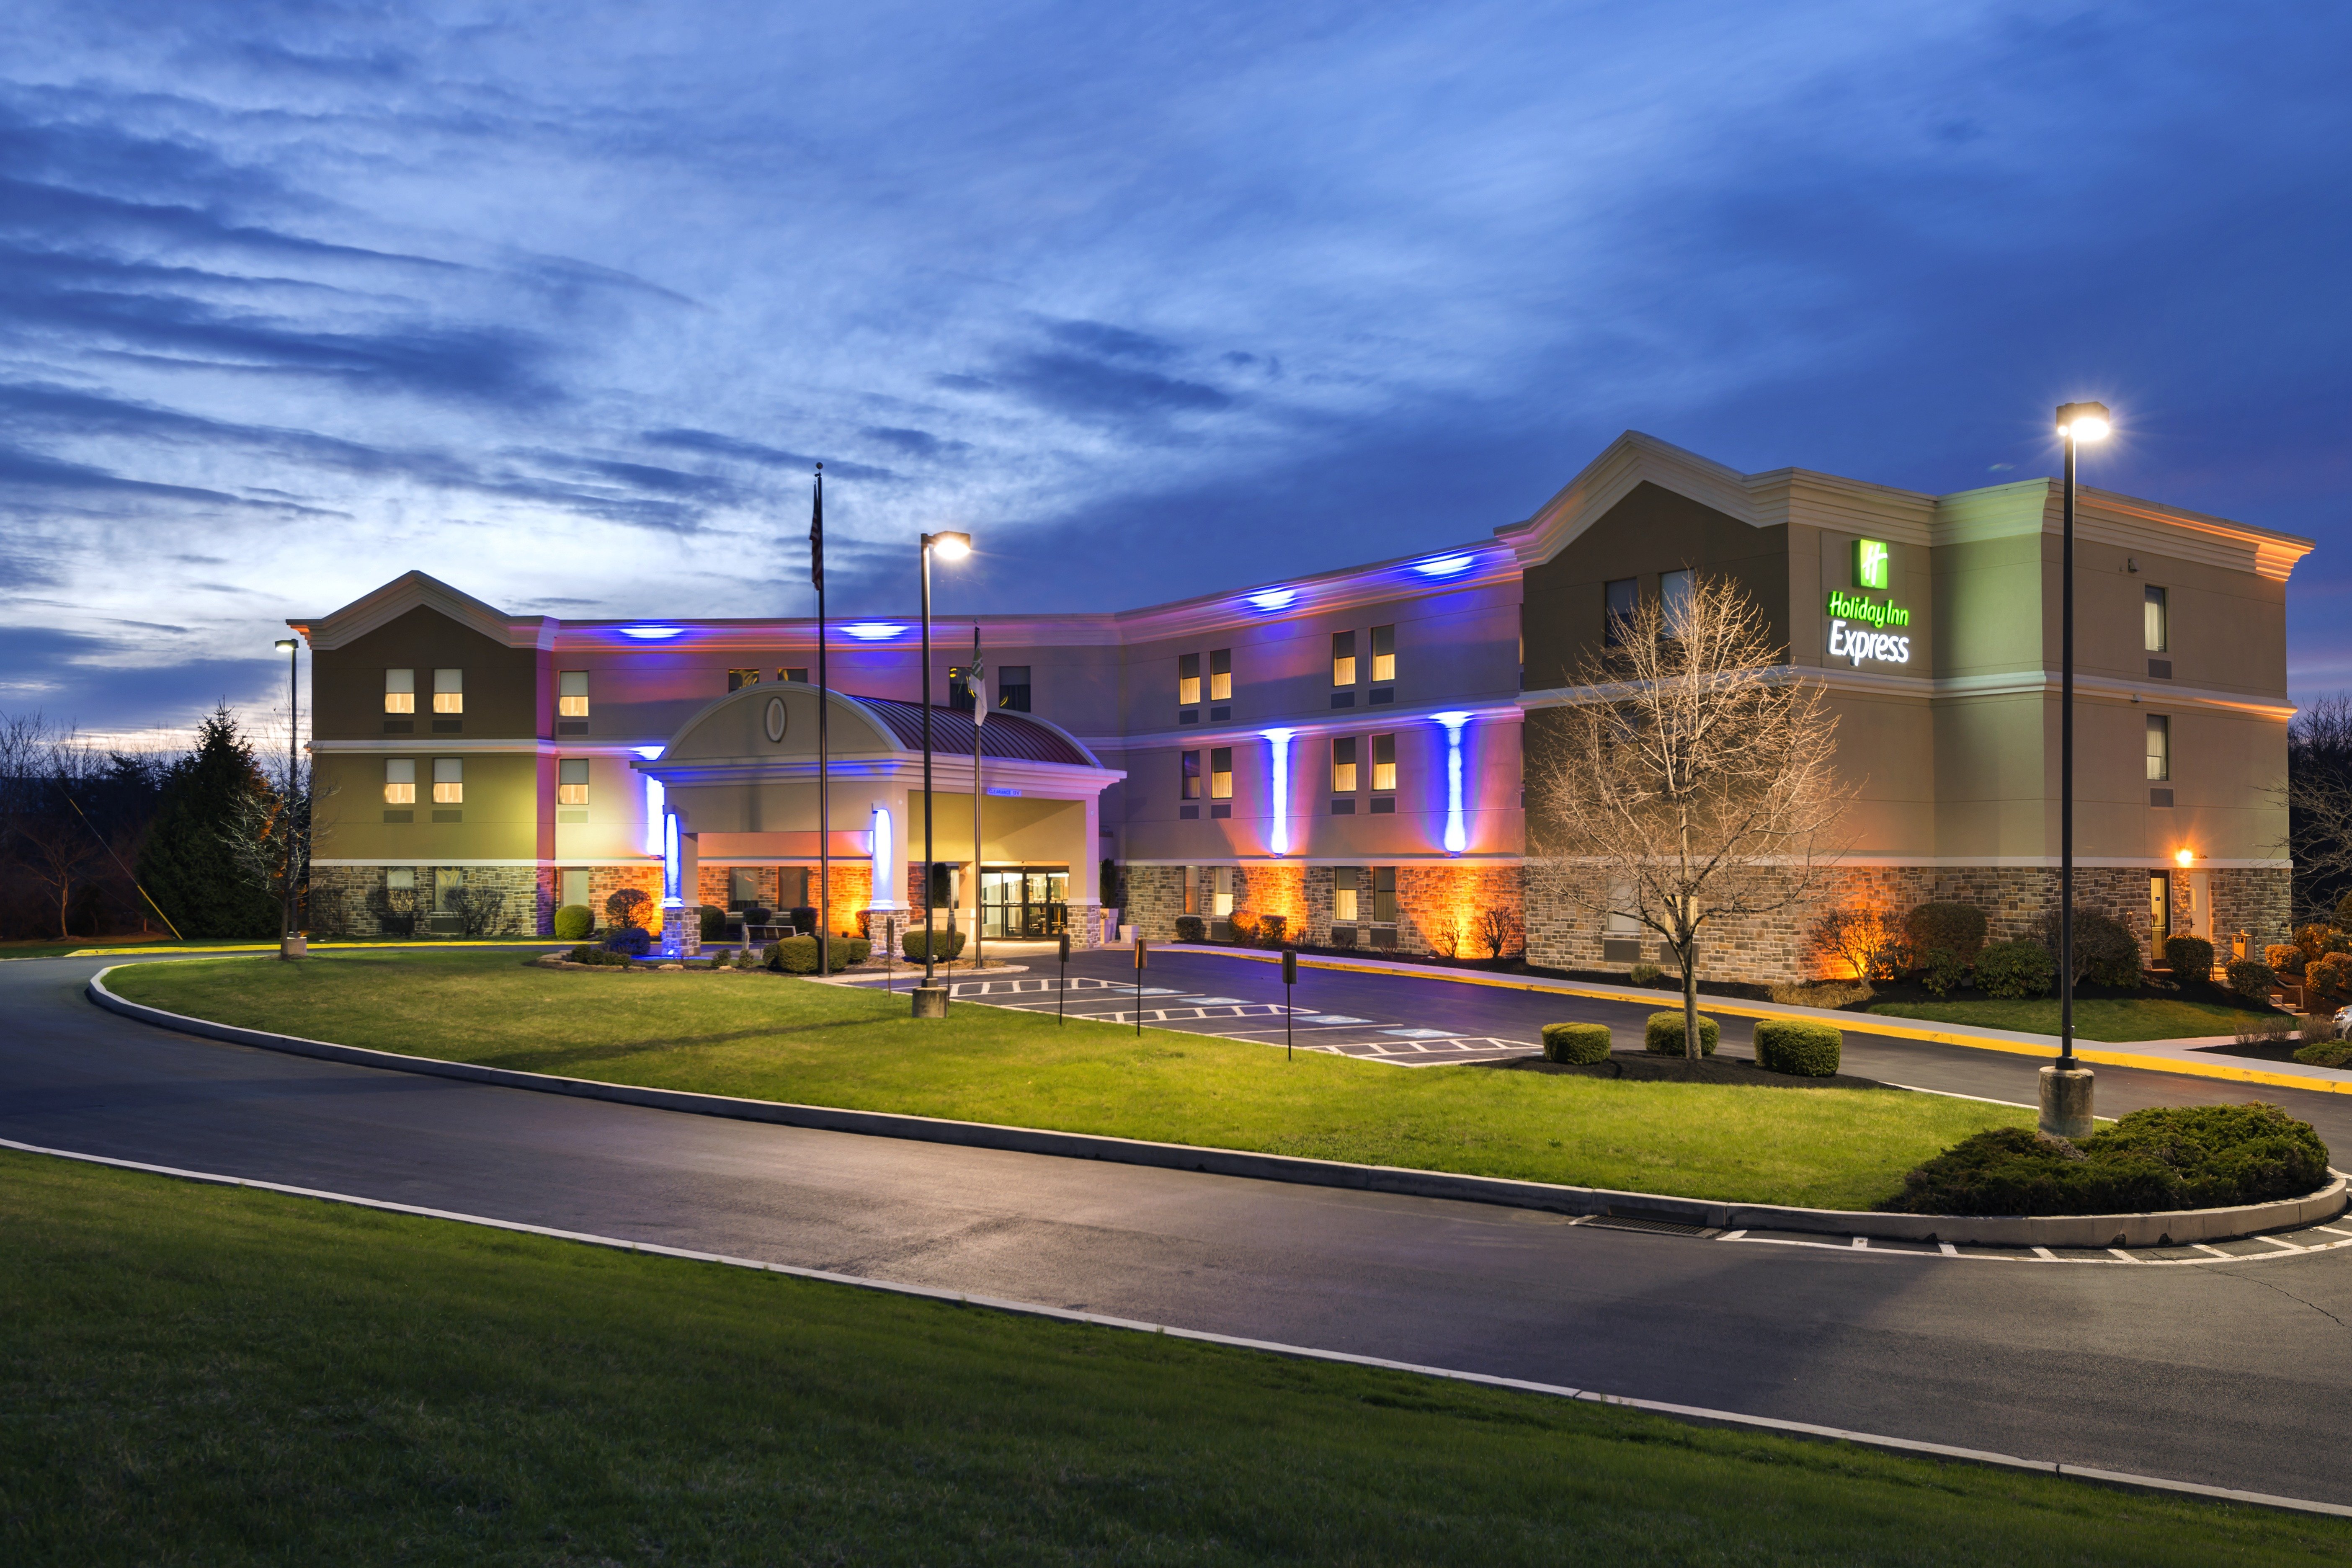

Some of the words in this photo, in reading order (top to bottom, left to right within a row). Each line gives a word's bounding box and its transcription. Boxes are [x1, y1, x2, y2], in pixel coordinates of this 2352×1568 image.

[1829, 591, 1885, 628] Holiday
[1887, 599, 1909, 626] Inn
[1830, 620, 1909, 666] Express
